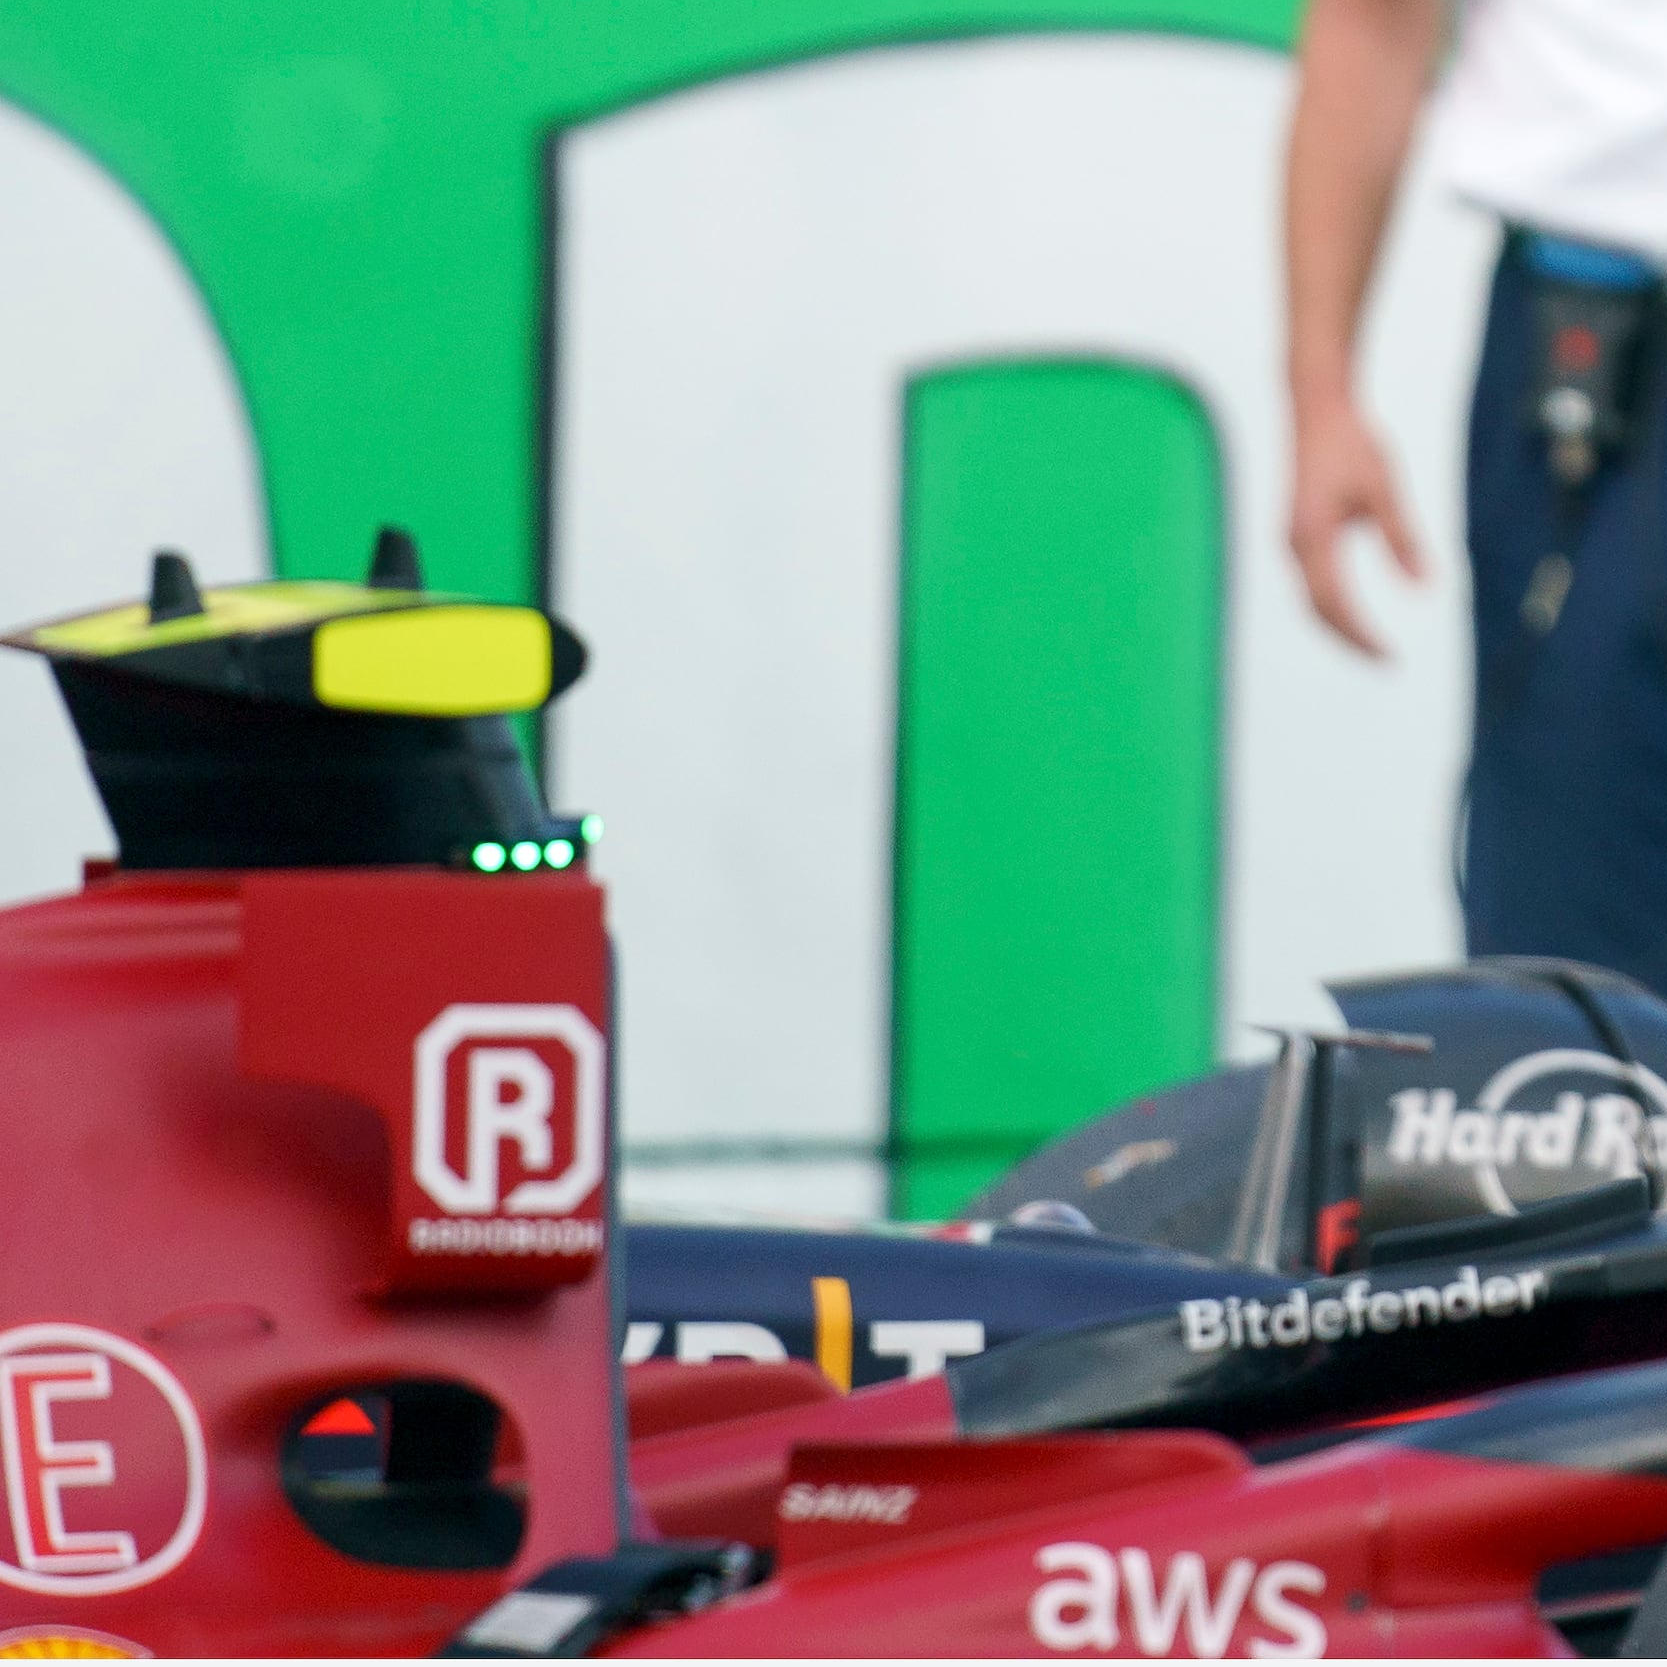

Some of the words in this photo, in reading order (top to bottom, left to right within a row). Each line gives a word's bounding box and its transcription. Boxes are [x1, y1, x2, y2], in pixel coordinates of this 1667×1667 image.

[1386, 1087, 1583, 1168] Hard
[1180, 1264, 1547, 1353] Bitdefender
[1027, 1540, 1329, 1658] aws
